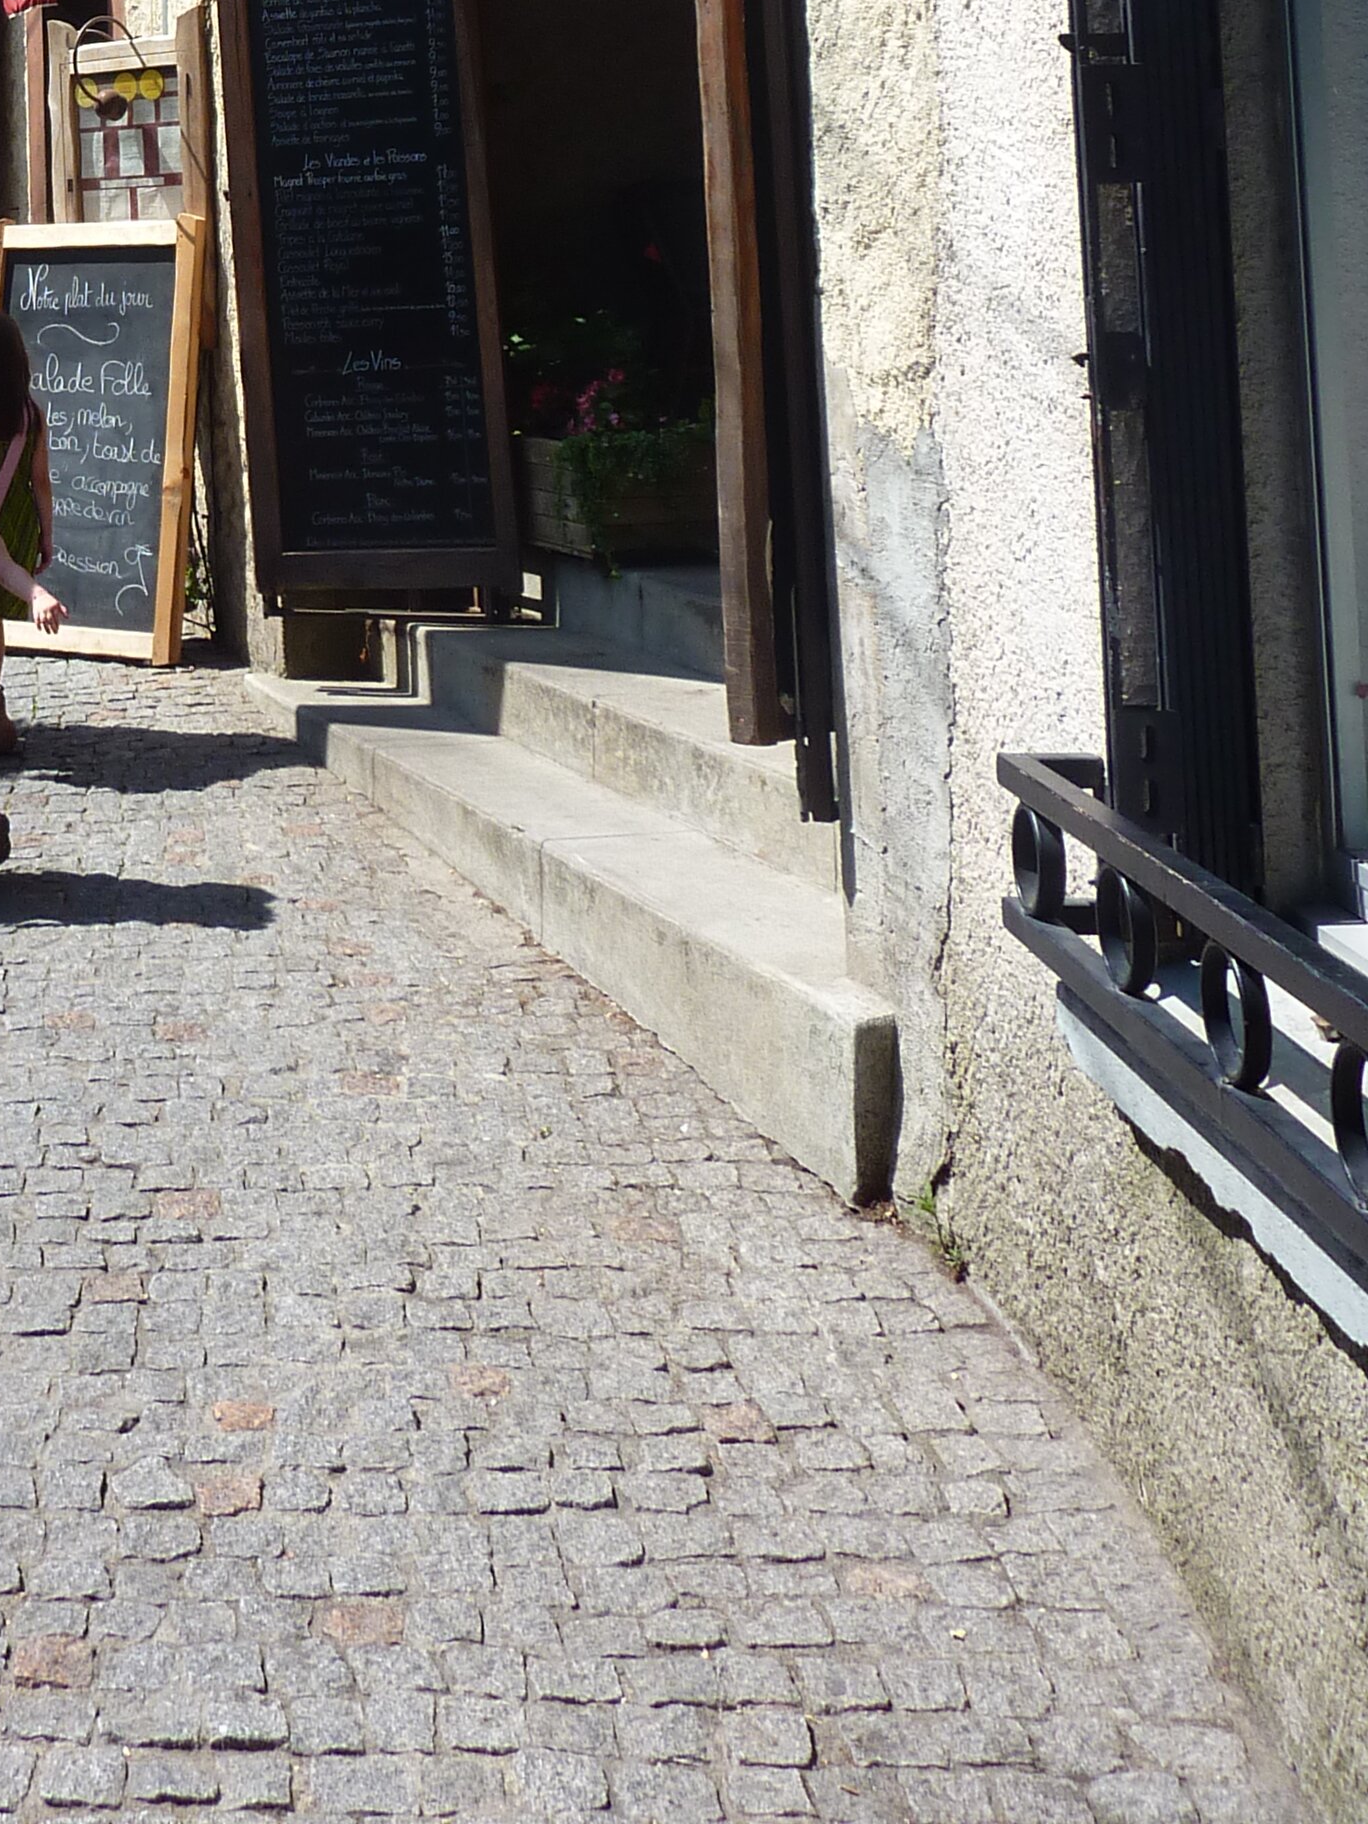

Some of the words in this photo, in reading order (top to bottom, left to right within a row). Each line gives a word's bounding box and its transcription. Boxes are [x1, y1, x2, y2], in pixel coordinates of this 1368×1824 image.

[303, 152, 323, 172] Les
[324, 150, 362, 168] Viandes
[373, 147, 387, 166] les
[386, 146, 429, 164] Poissons
[20, 264, 61, 311] Notre
[64, 276, 93, 316] plat
[95, 282, 117, 307] du
[119, 280, 153, 316] jour
[29, 353, 95, 393] alade
[100, 360, 152, 397] Folle
[341, 350, 370, 376] Les
[370, 348, 402, 372] Vins
[49, 430, 89, 465] bon,
[92, 430, 137, 463] toast
[139, 439, 162, 465] de
[106, 509, 134, 526] vin
